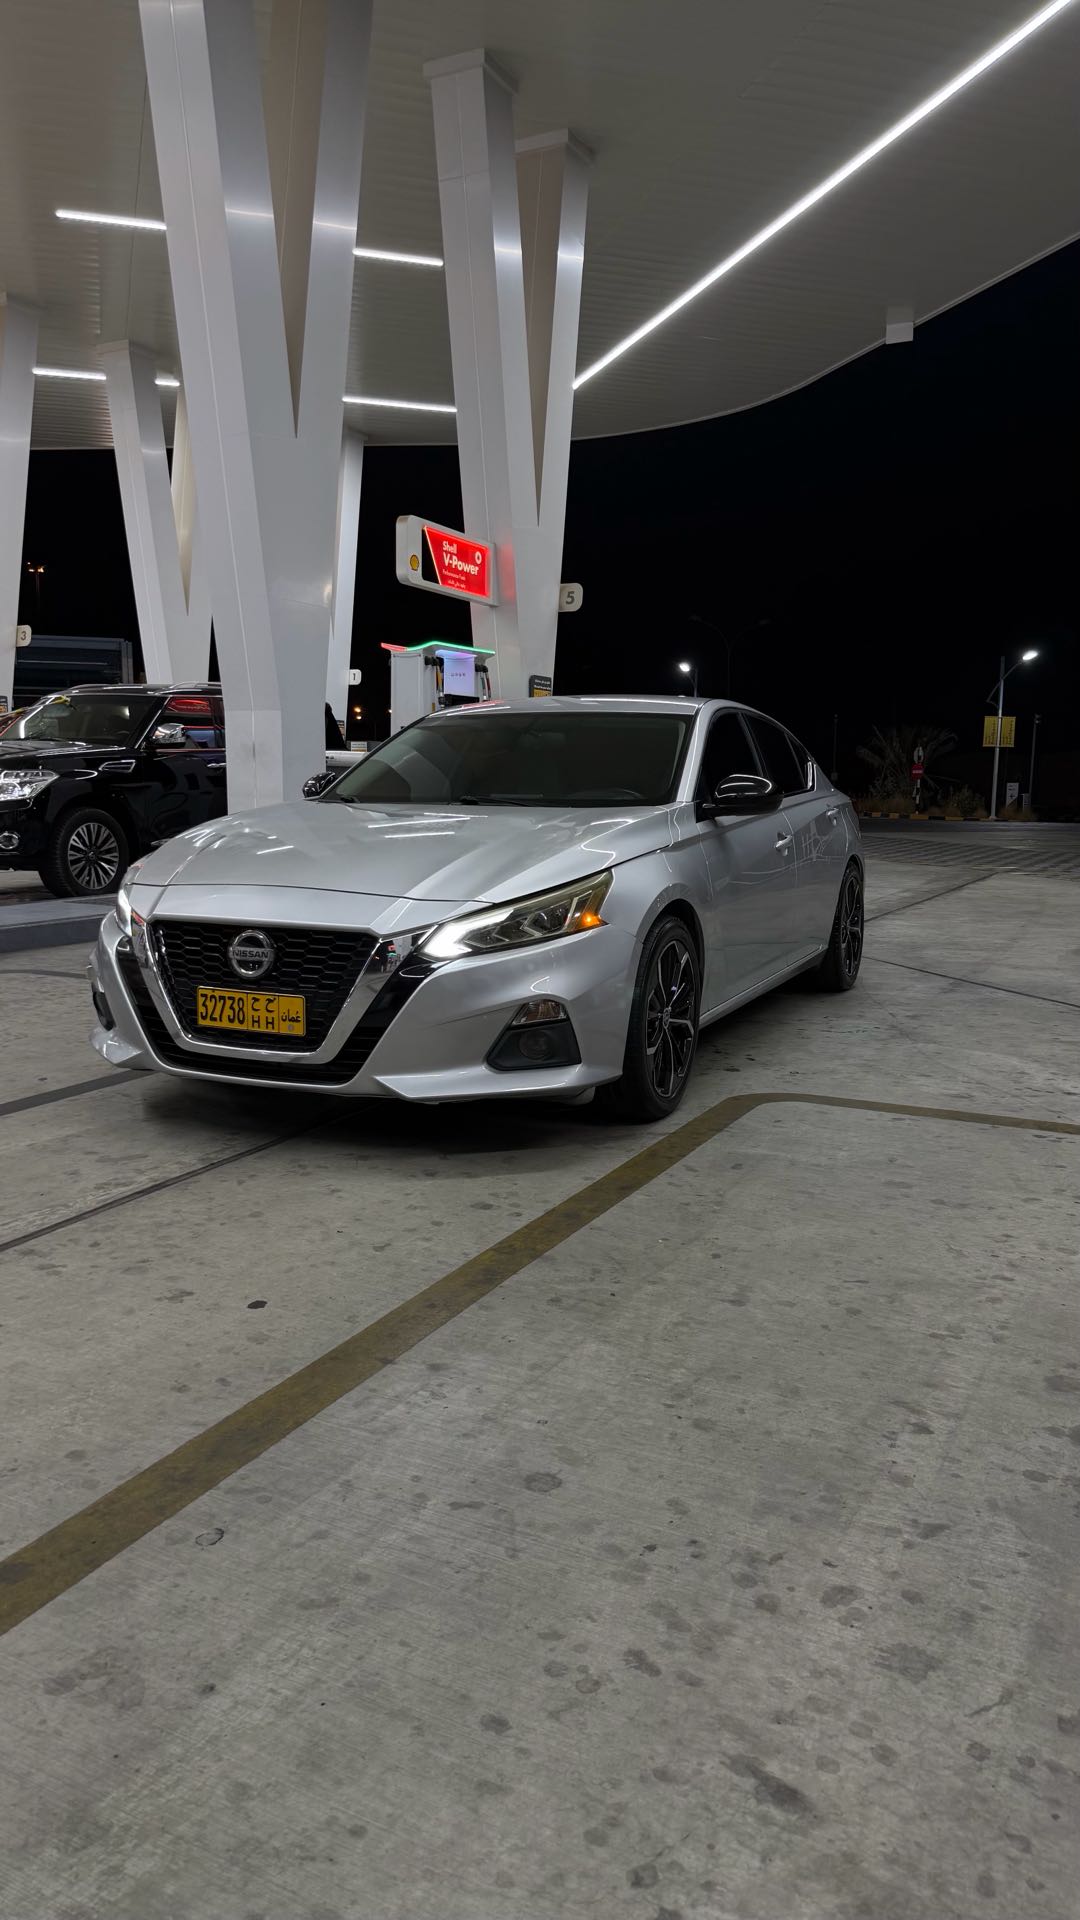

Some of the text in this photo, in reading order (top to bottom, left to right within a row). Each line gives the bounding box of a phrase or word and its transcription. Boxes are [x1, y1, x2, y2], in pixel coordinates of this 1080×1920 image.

[442, 541, 458, 554] Shell
[442, 552, 480, 575] V-Power
[565, 591, 575, 605] 5
[20, 630, 27, 641] 3
[232, 950, 269, 959] NISSAN
[200, 993, 246, 1025] 32738
